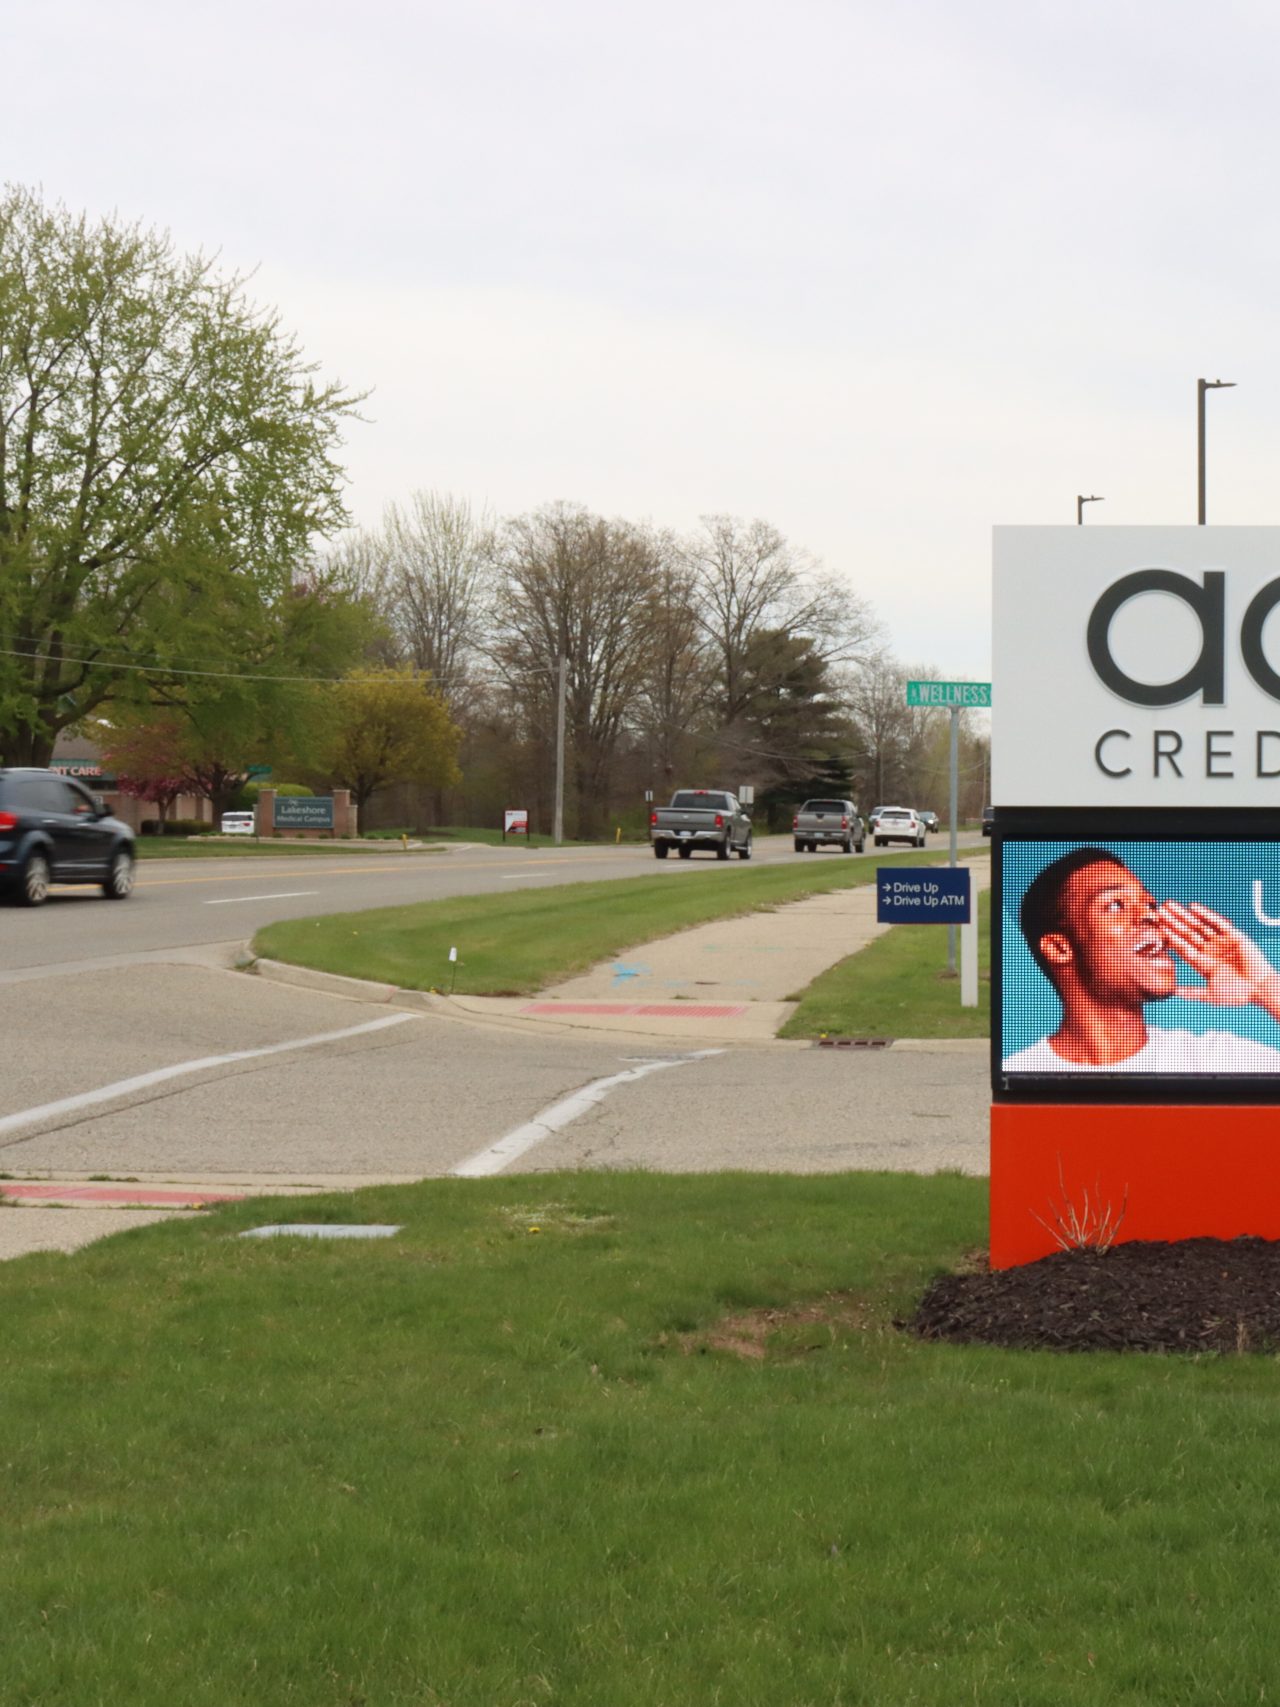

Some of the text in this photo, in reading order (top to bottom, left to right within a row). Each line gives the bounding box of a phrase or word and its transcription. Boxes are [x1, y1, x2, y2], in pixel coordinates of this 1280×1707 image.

[920, 684, 989, 705] WELLNESS
[70, 766, 102, 776] CARE
[281, 805, 326, 815] Lakeshore
[893, 882, 939, 895] Drive Up
[893, 895, 965, 908] Drive Up ATM
